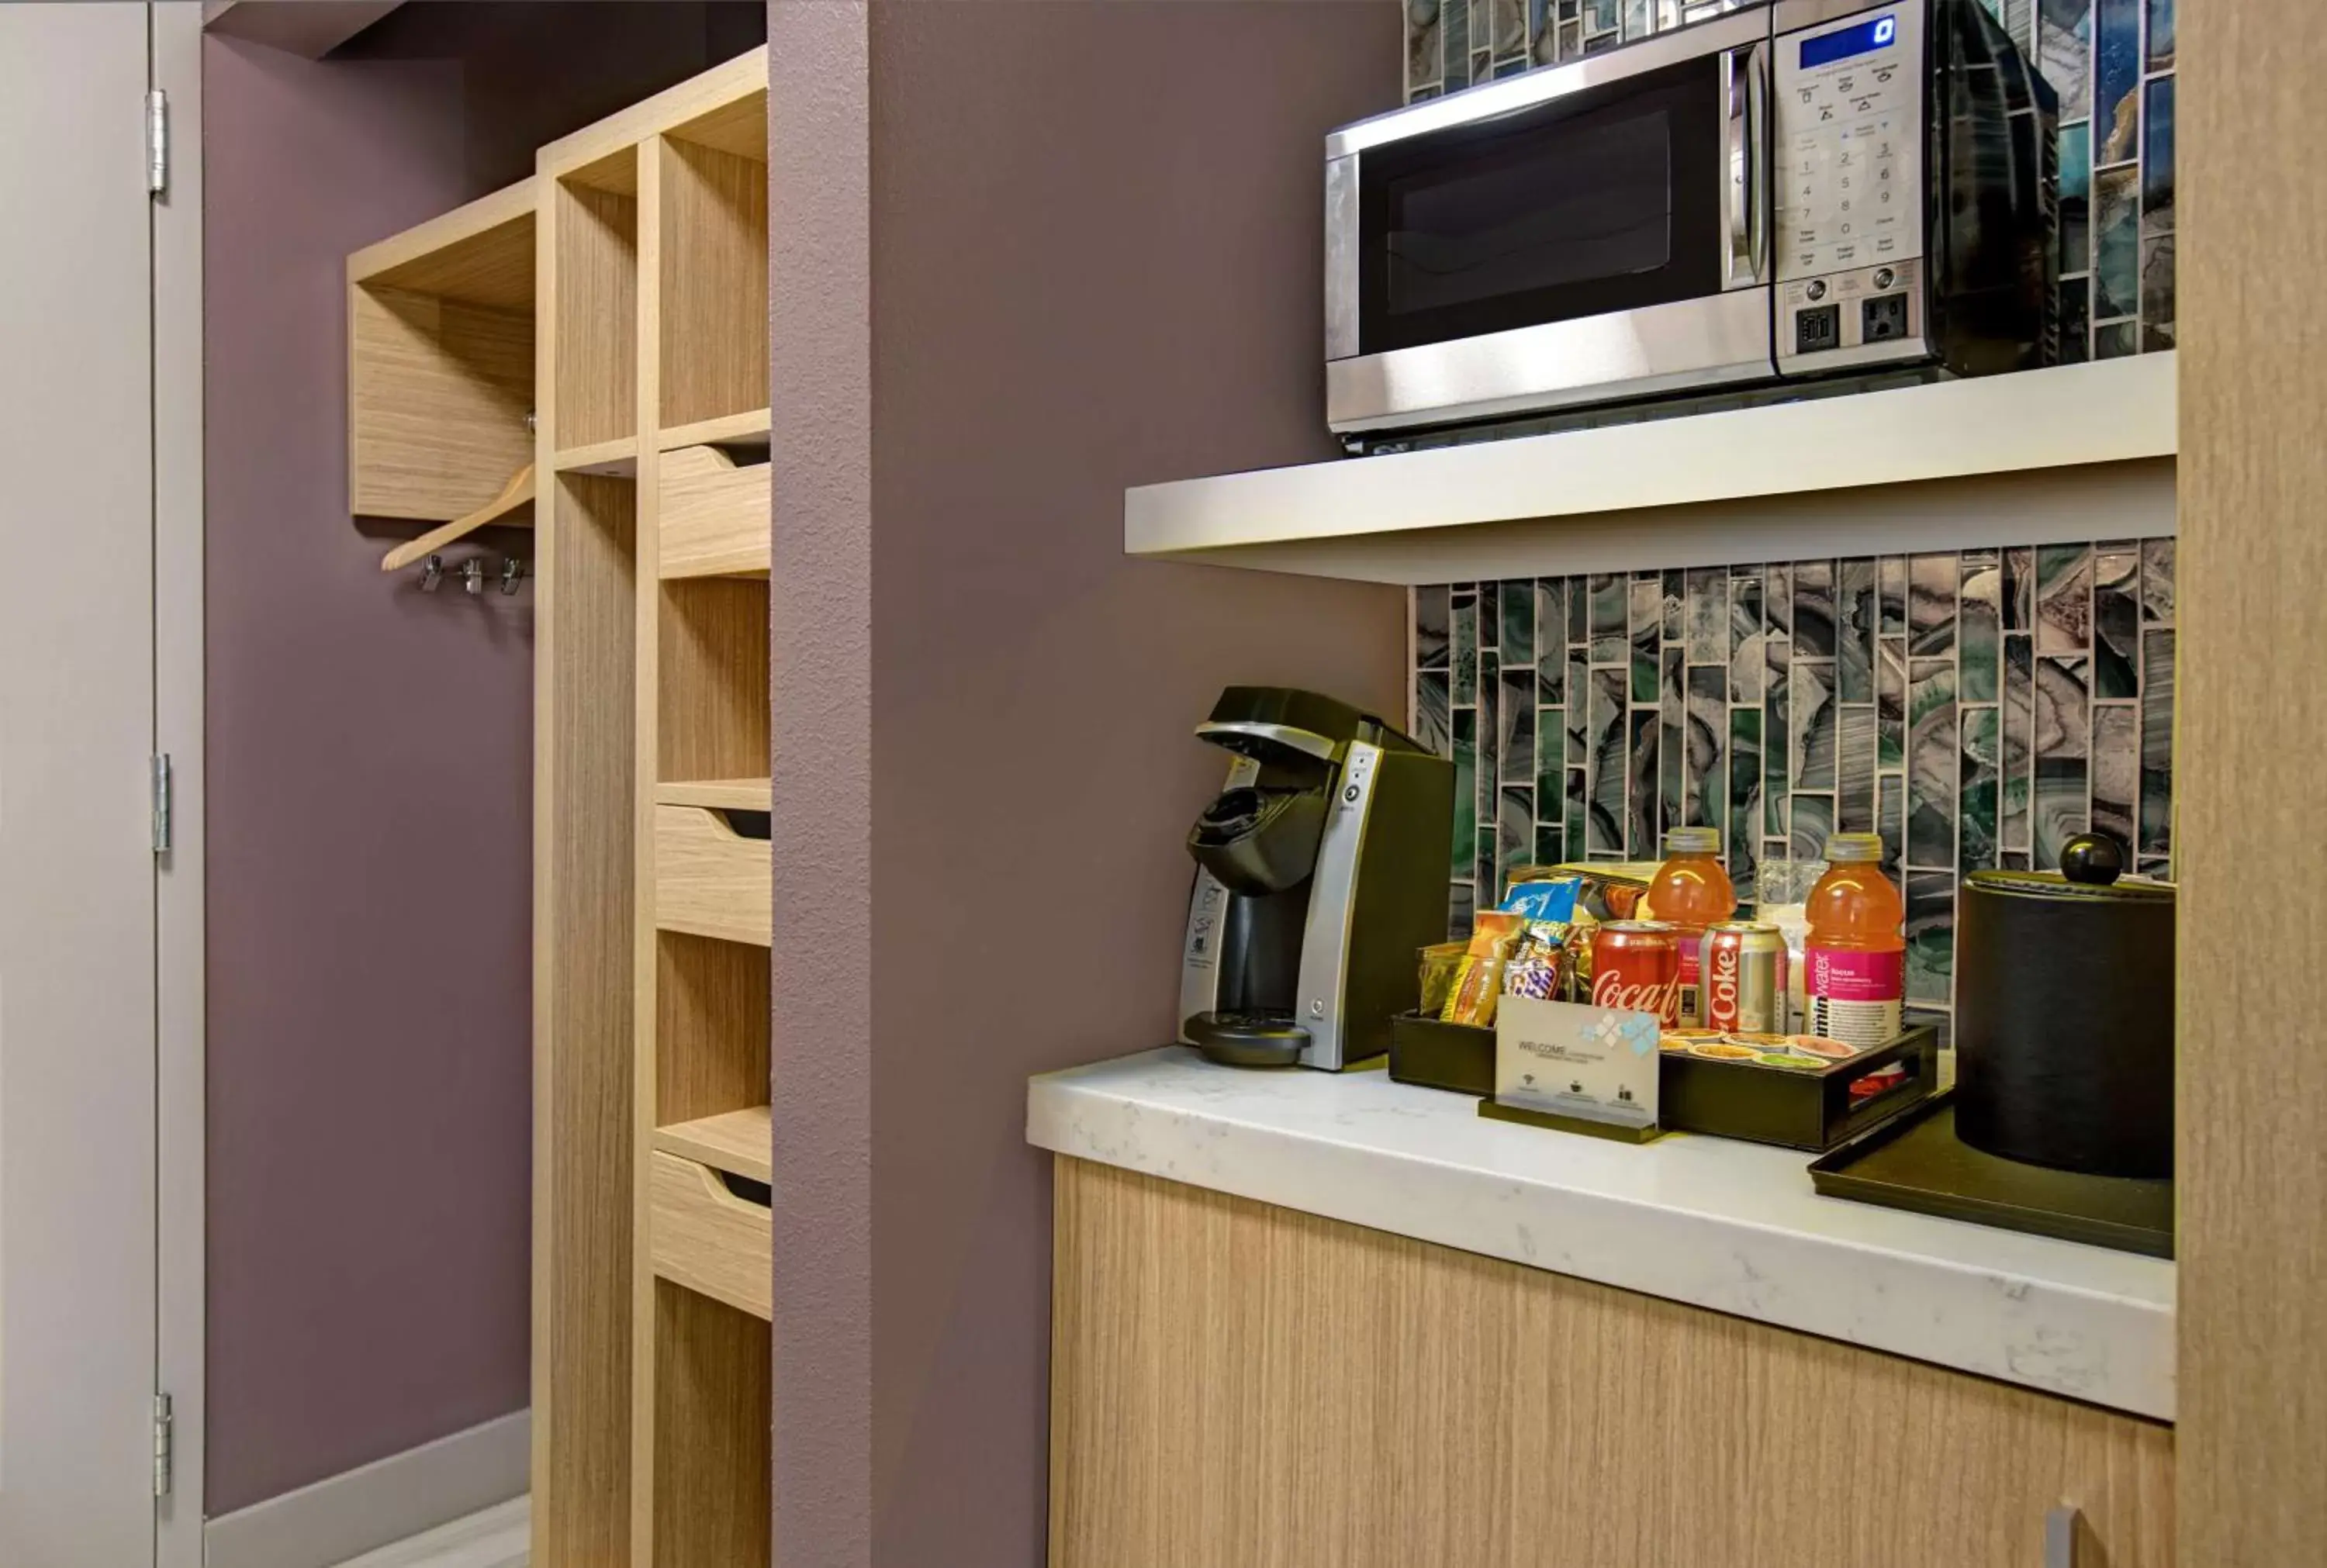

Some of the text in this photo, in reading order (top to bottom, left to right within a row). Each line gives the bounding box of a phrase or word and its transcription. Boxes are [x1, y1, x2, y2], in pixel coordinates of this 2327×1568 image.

[1873, 18, 1894, 43] 0
[1840, 151, 1849, 164] 2
[1880, 167, 1890, 180] 6
[1841, 176, 1849, 189] 5
[1803, 185, 1811, 195] 4
[1880, 191, 1890, 203] 9
[1841, 199, 1850, 212] 8
[1803, 208, 1811, 219] 7
[1841, 222, 1850, 234] 0
[1711, 950, 1737, 1021] Coke
[1518, 1041, 1566, 1055] WELCOME
